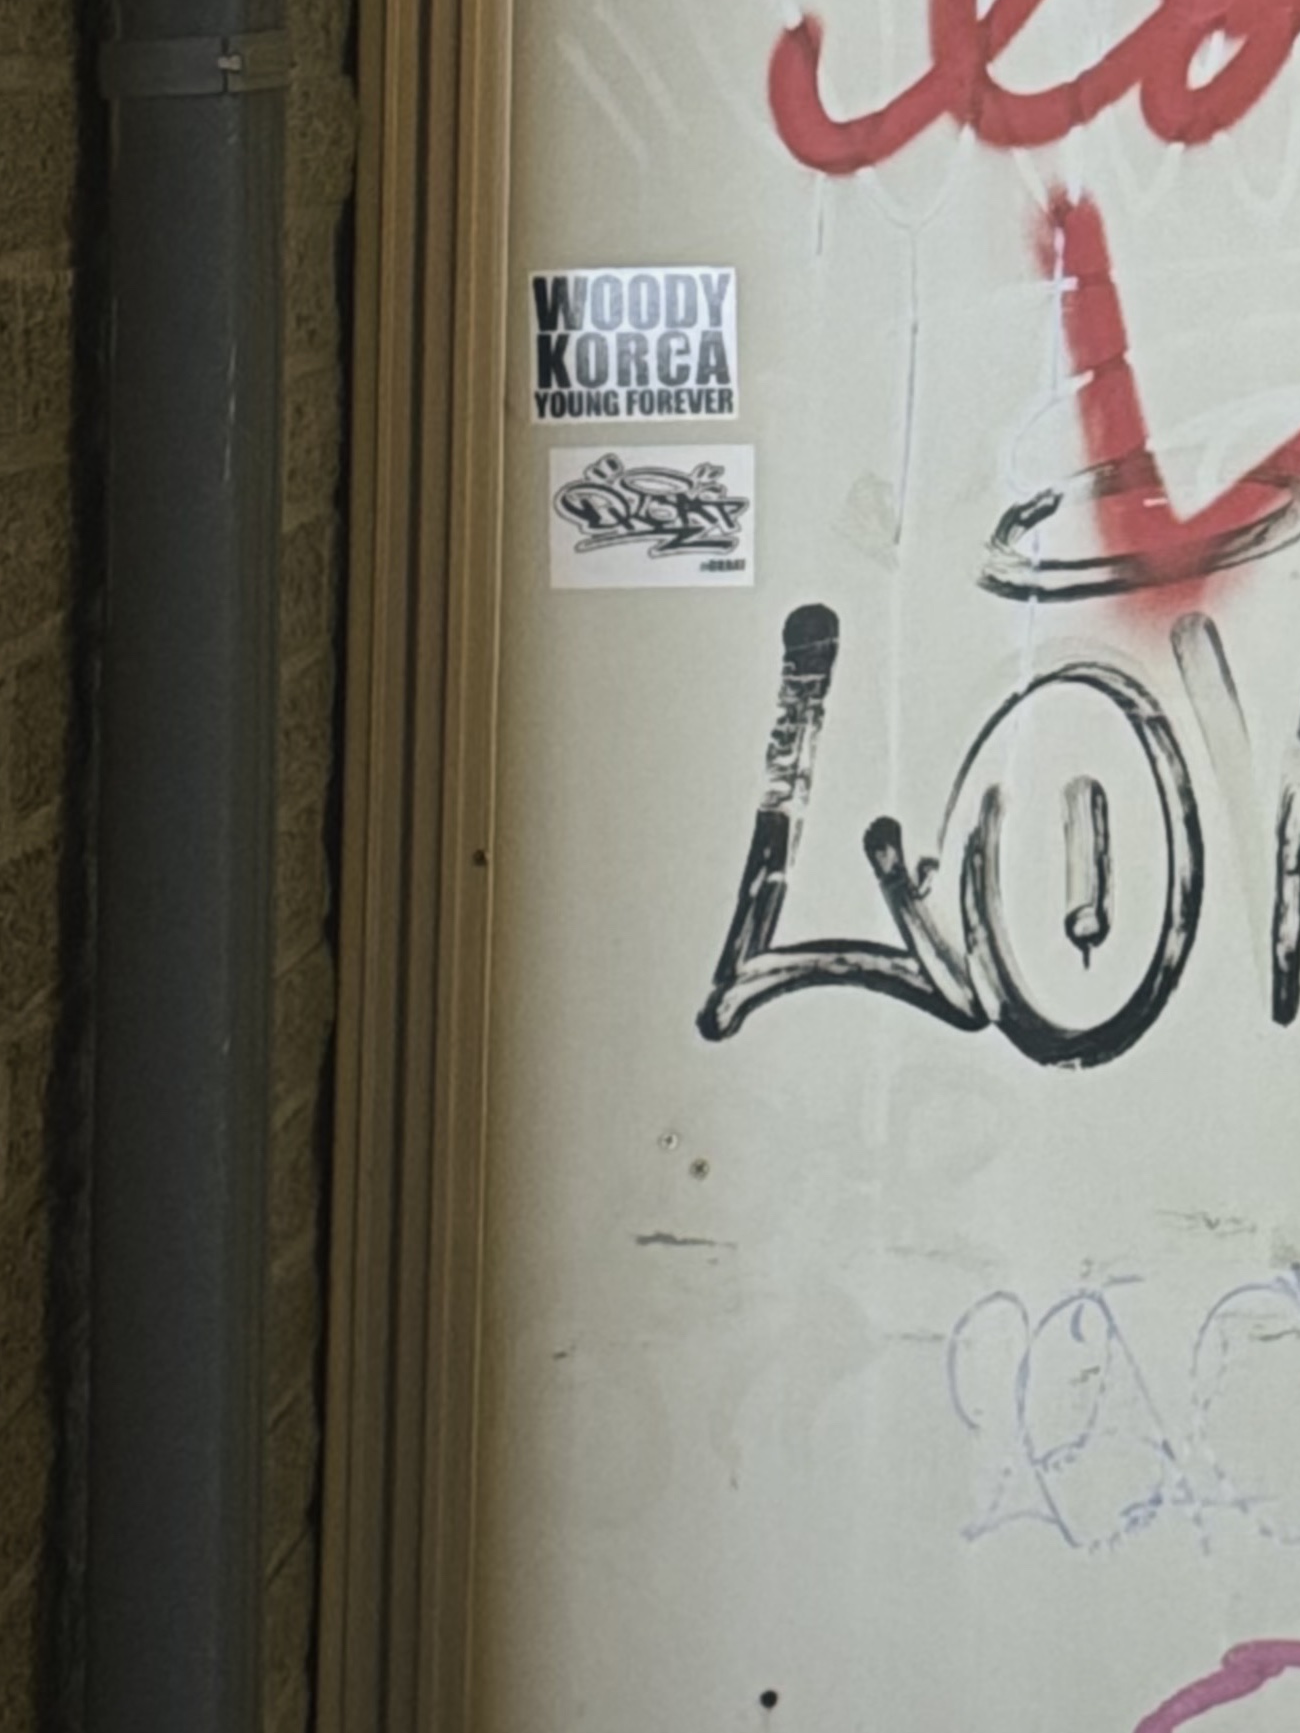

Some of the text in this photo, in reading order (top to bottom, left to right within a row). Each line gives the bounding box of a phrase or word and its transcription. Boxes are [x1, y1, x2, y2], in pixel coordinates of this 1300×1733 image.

[533, 272, 732, 332] WOODY
[536, 330, 732, 390] KORCA
[534, 387, 735, 419] YOUNG FOREVER
